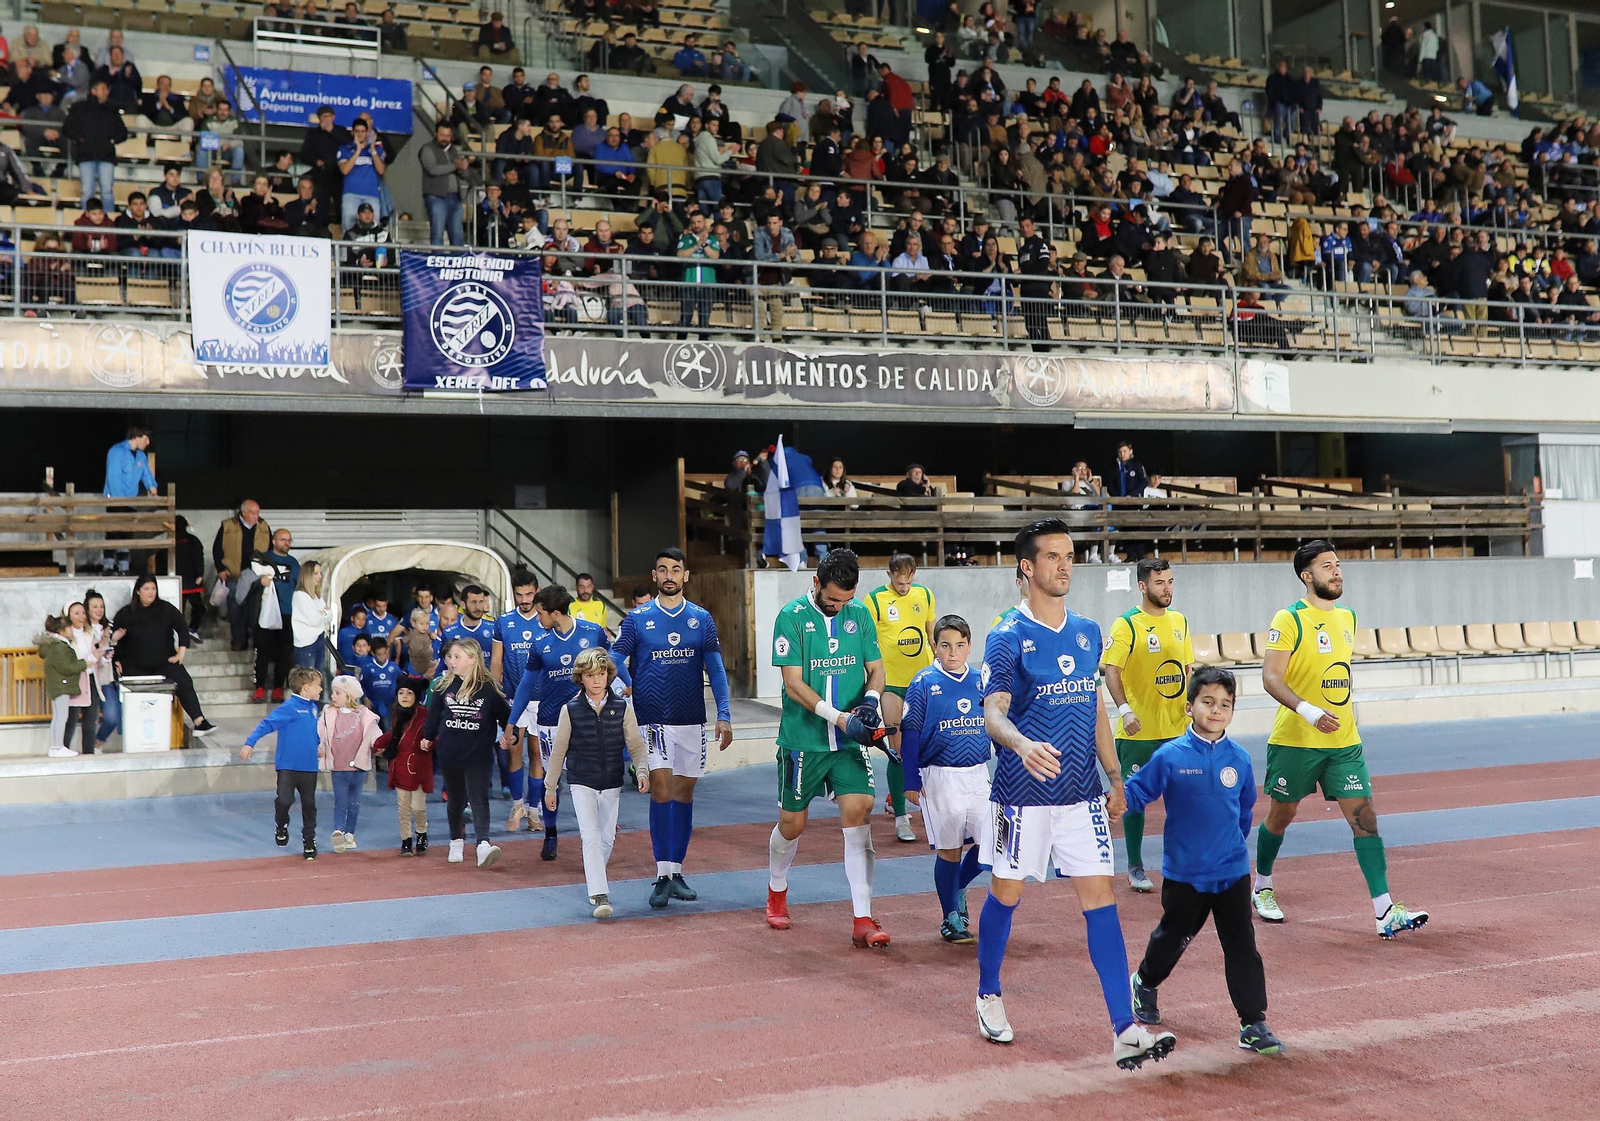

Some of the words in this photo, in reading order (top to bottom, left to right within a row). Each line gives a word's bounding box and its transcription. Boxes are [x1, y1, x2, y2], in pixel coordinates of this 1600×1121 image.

[260, 87, 350, 107] Ayuntamiento
[352, 93, 368, 107] de
[370, 96, 402, 110] Jerez
[260, 101, 304, 113] Deportes
[200, 238, 265, 255] CHAPÍN
[270, 244, 319, 258] BLUES
[427, 255, 514, 270] ESCRIBIENDO
[439, 268, 504, 282] HISTORIA
[456, 286, 487, 296] 1911
[244, 281, 277, 317] XEREZ
[235, 317, 289, 333] DEPORTIVO
[455, 305, 491, 348] XEREZ
[442, 343, 507, 364] DEPORTIVO
[435, 375, 486, 389] XEREZ
[492, 376, 520, 389] DFC
[735, 359, 868, 389] ALIMENTOS
[878, 365, 904, 390] DE
[914, 367, 1003, 392] CALIDA
[651, 648, 695, 660] prefortia
[1035, 677, 1096, 700] prefortia
[1049, 695, 1090, 706] academia
[445, 719, 480, 731] adidas
